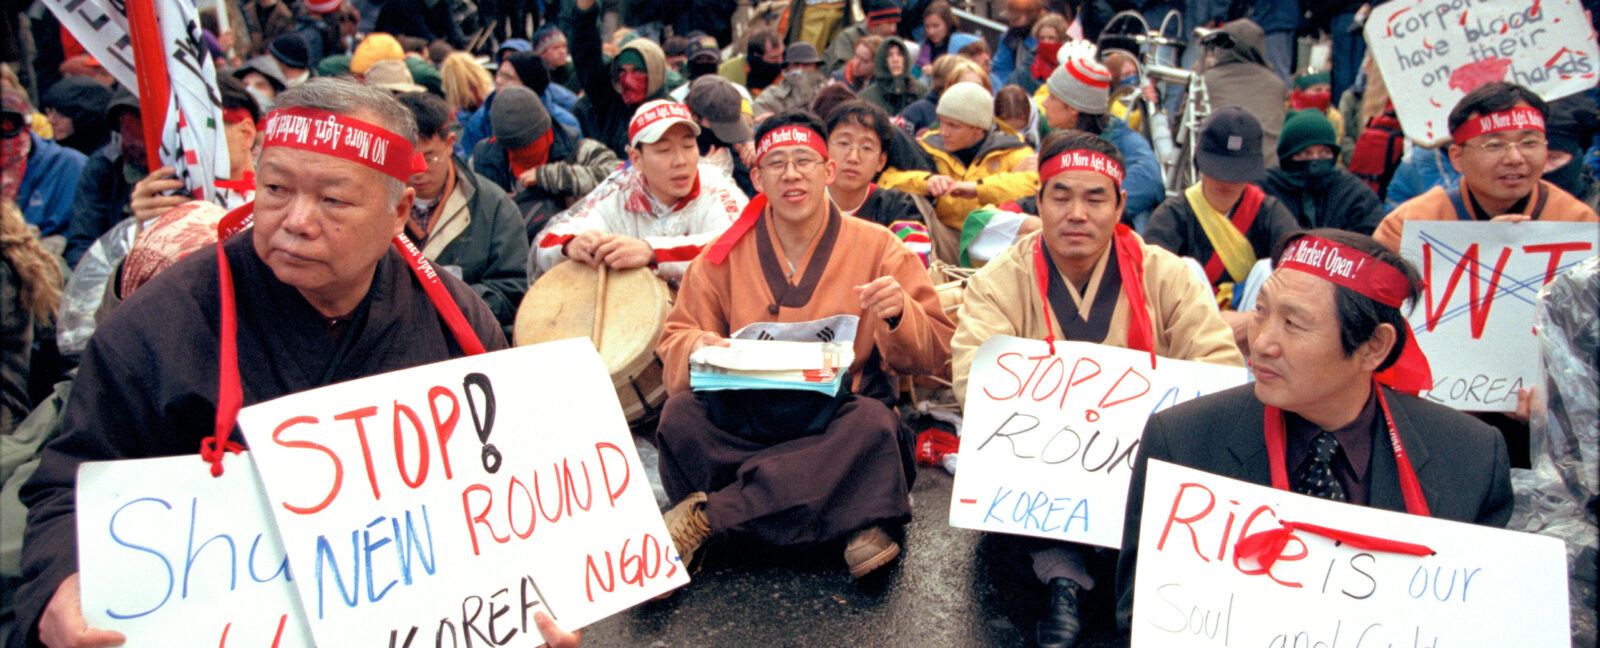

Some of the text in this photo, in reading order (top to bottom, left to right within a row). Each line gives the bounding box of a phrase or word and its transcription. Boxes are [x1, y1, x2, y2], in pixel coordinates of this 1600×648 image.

[1393, 0, 1486, 38] corpo
[1395, 40, 1449, 70] have
[1422, 28, 1546, 87] on their
[1512, 55, 1593, 86] hands
[275, 115, 312, 144] Market
[313, 115, 345, 150] Agri.
[771, 128, 791, 145] Market
[1481, 116, 1491, 133] NO
[1491, 112, 1511, 129] More
[345, 126, 374, 160] More
[371, 137, 390, 166] NO
[1061, 154, 1071, 168] NO
[1072, 152, 1089, 167] More
[1293, 240, 1327, 269] Market
[1324, 247, 1355, 277] Open
[1426, 373, 1525, 405] KOREA
[977, 411, 1141, 475] ROUN
[984, 486, 1089, 532] KOREA
[315, 442, 631, 619] NEW ROUND
[1157, 483, 1309, 589] Rice
[1408, 563, 1483, 603] our
[585, 533, 678, 603] NGOs
[1149, 583, 1234, 647] Soul
